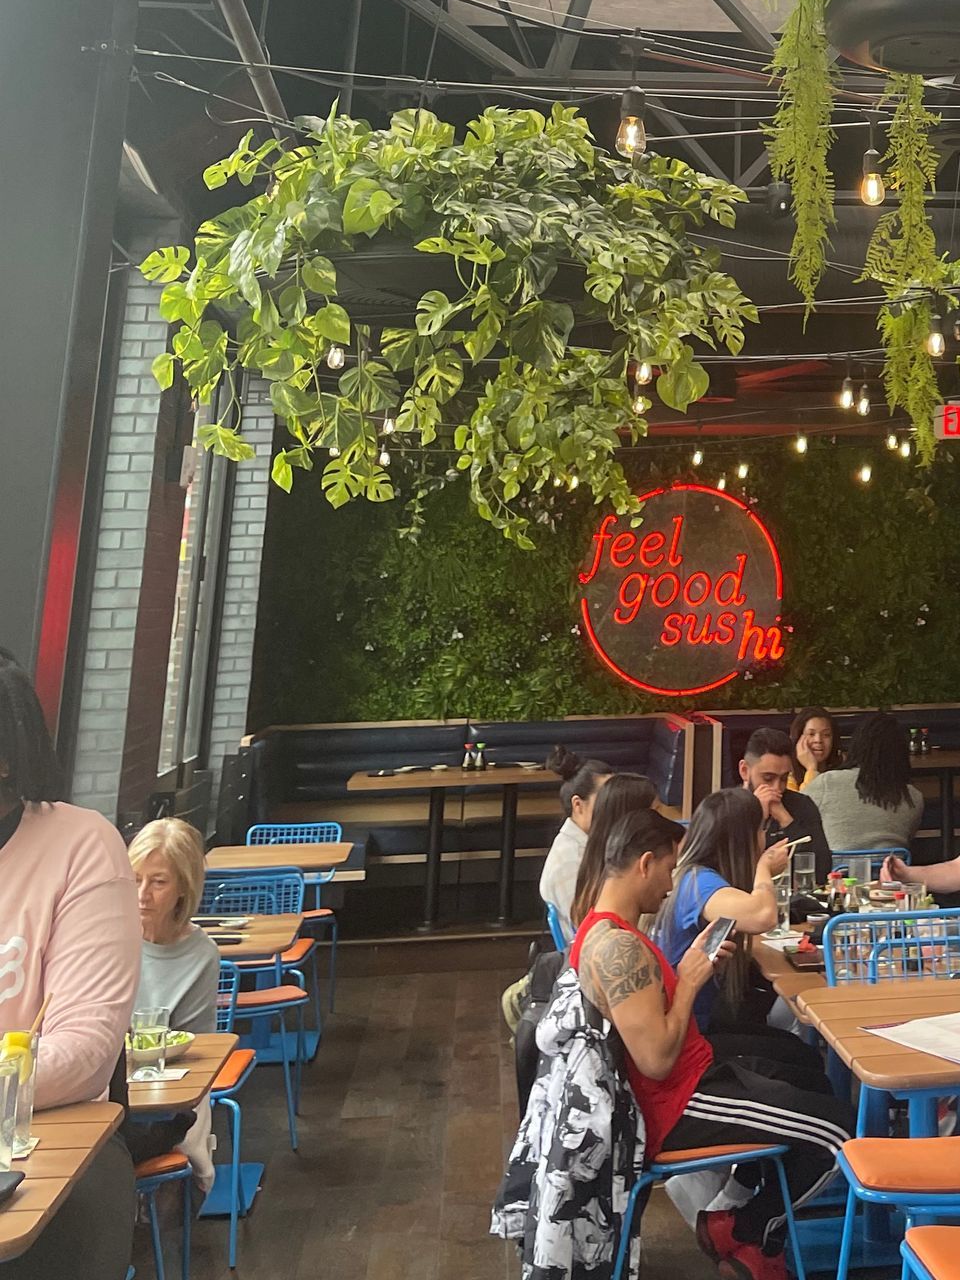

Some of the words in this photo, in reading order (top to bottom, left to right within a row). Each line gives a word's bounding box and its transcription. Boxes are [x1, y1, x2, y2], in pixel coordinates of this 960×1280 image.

[578, 515, 683, 584] feel
[613, 553, 748, 624] good
[660, 609, 785, 660] sushi
